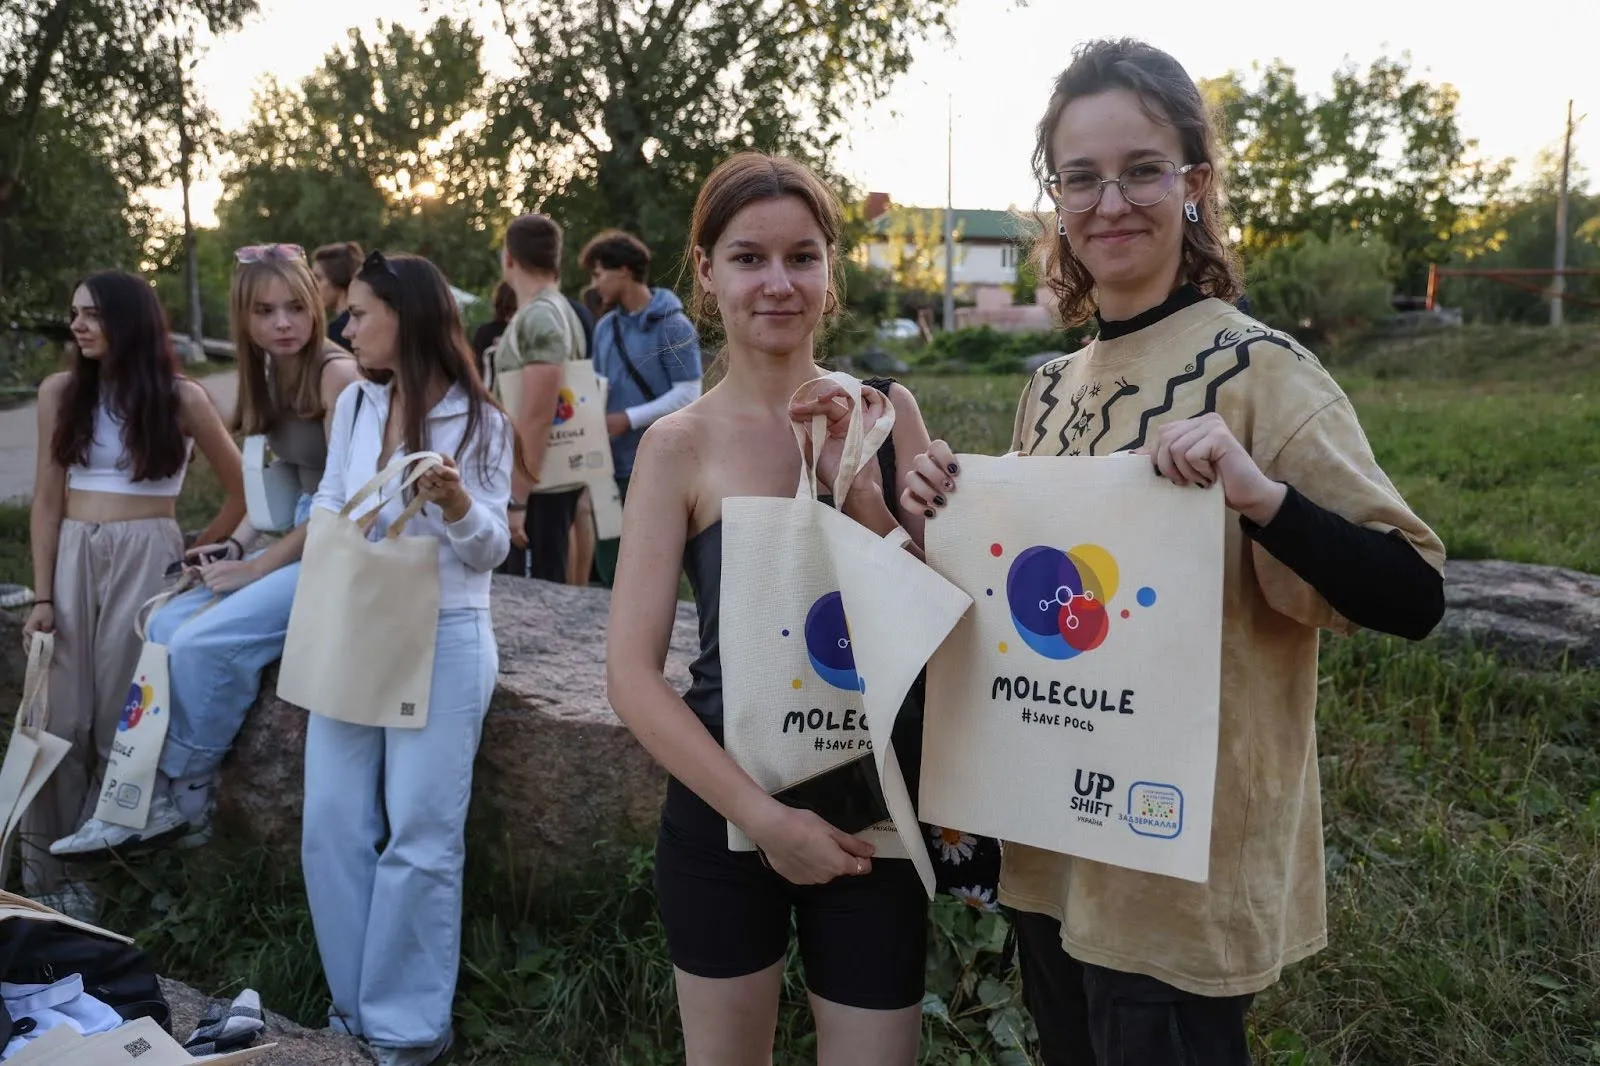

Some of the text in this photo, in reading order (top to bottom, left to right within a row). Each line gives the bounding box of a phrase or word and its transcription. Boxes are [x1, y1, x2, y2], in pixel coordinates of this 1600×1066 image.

[991, 675, 1135, 715] MOLECULE
[782, 708, 869, 733] MOLEC
[1021, 707, 1061, 726] #SAVE
[814, 736, 854, 752] #SAVE
[1074, 768, 1115, 800] UP
[1069, 796, 1113, 818] SHIFT
[1077, 815, 1103, 827] УКРАЇНА
[1117, 813, 1177, 829] ЗАДЗЕРКАЛЛЯ
